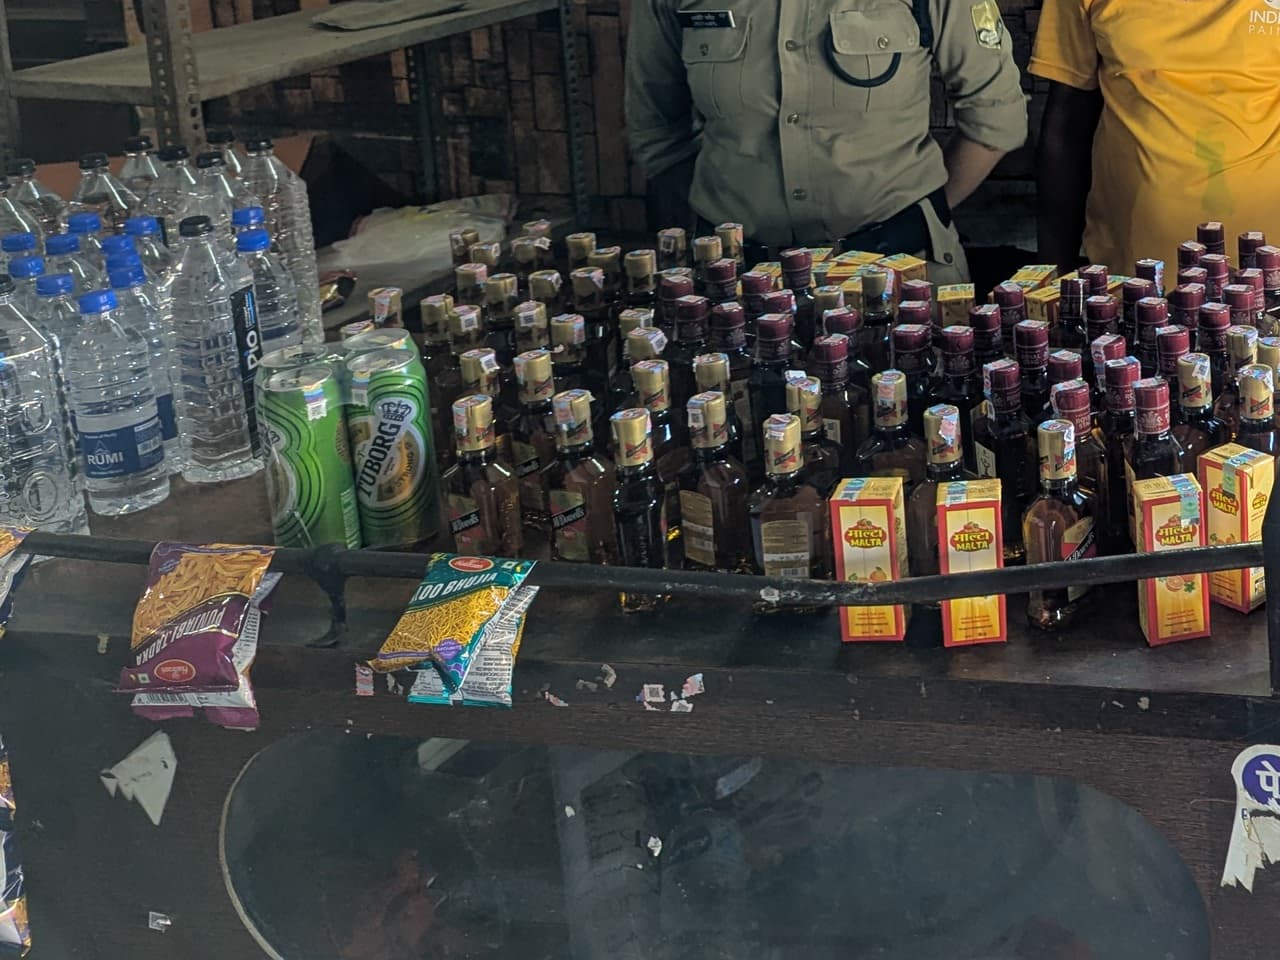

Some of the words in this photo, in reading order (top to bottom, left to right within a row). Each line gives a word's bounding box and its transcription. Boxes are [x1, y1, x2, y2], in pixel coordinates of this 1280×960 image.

[357, 421, 402, 498] TUBORG
[1213, 500, 1238, 516] MALTA
[848, 528, 883, 539] माल्टा
[954, 531, 990, 542] माल्टा
[1161, 534, 1193, 546] MALTA
[849, 538, 883, 548] MALTA
[956, 541, 990, 552] MALTA
[441, 572, 499, 596] BHUJIA
[171, 607, 227, 642] PUNJABI
[135, 631, 170, 666] TADKA
